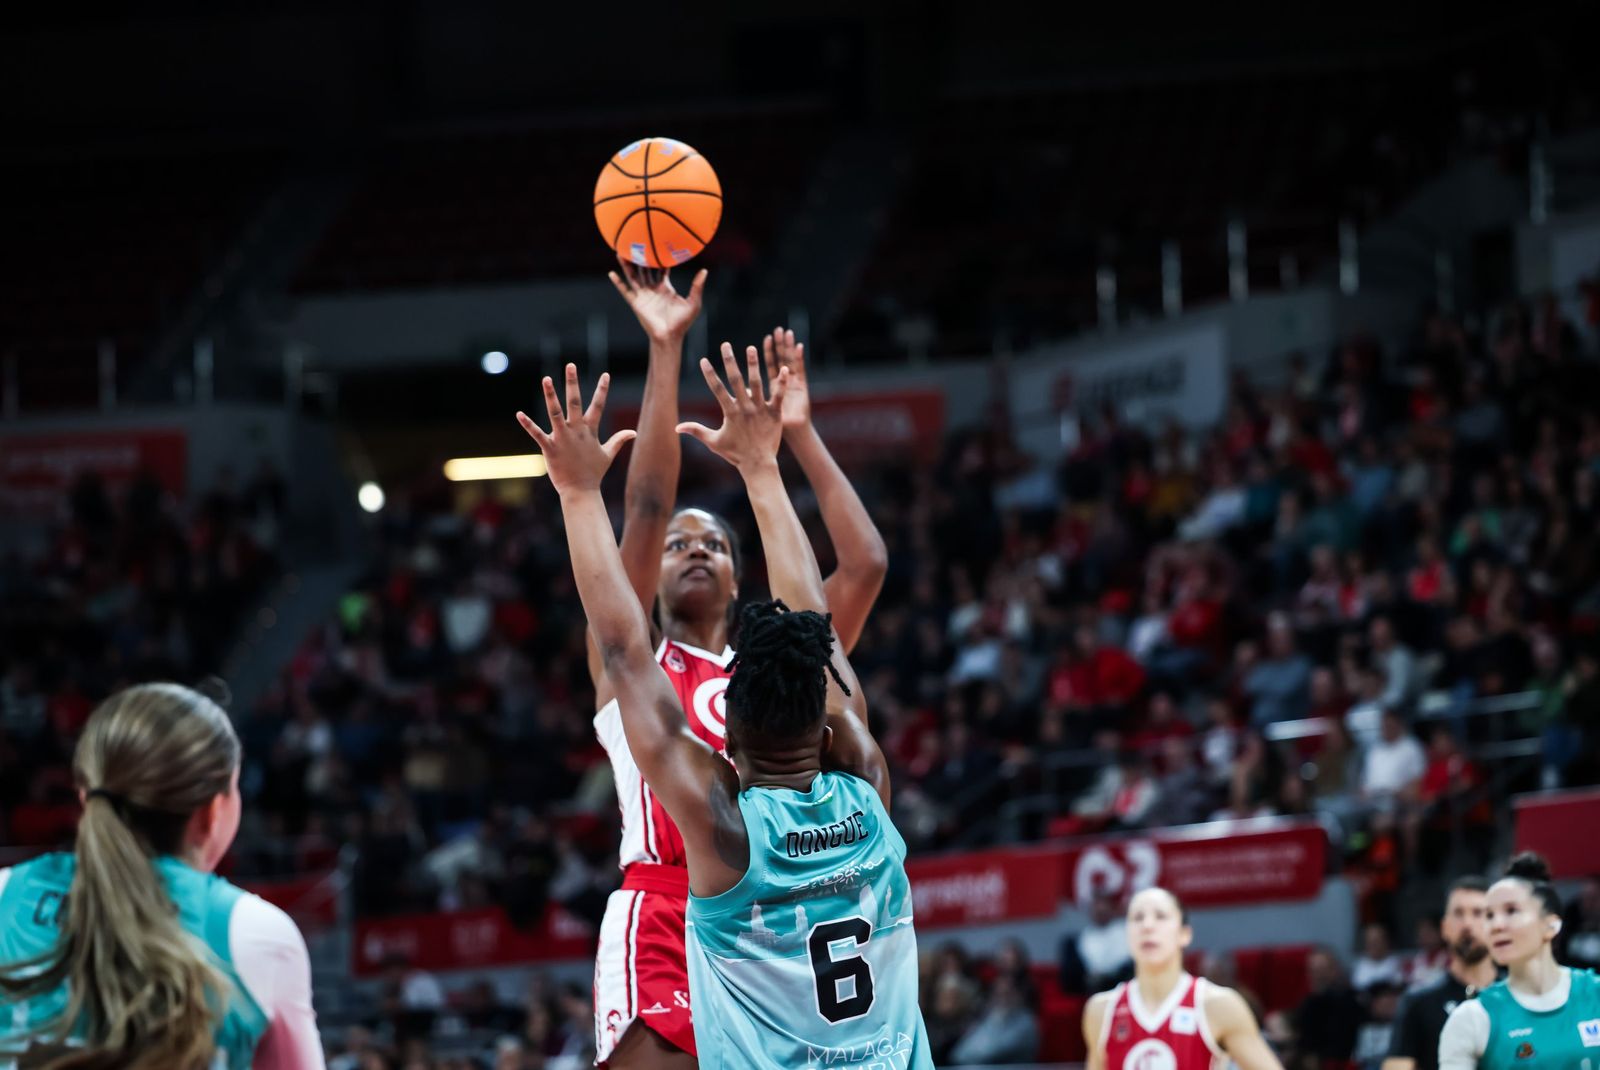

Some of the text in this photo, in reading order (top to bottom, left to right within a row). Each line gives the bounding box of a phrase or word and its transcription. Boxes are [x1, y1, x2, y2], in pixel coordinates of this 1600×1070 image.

[787, 812, 869, 857] DONGUE
[807, 917, 875, 1025] 6
[807, 1032, 913, 1065] MALAGA
